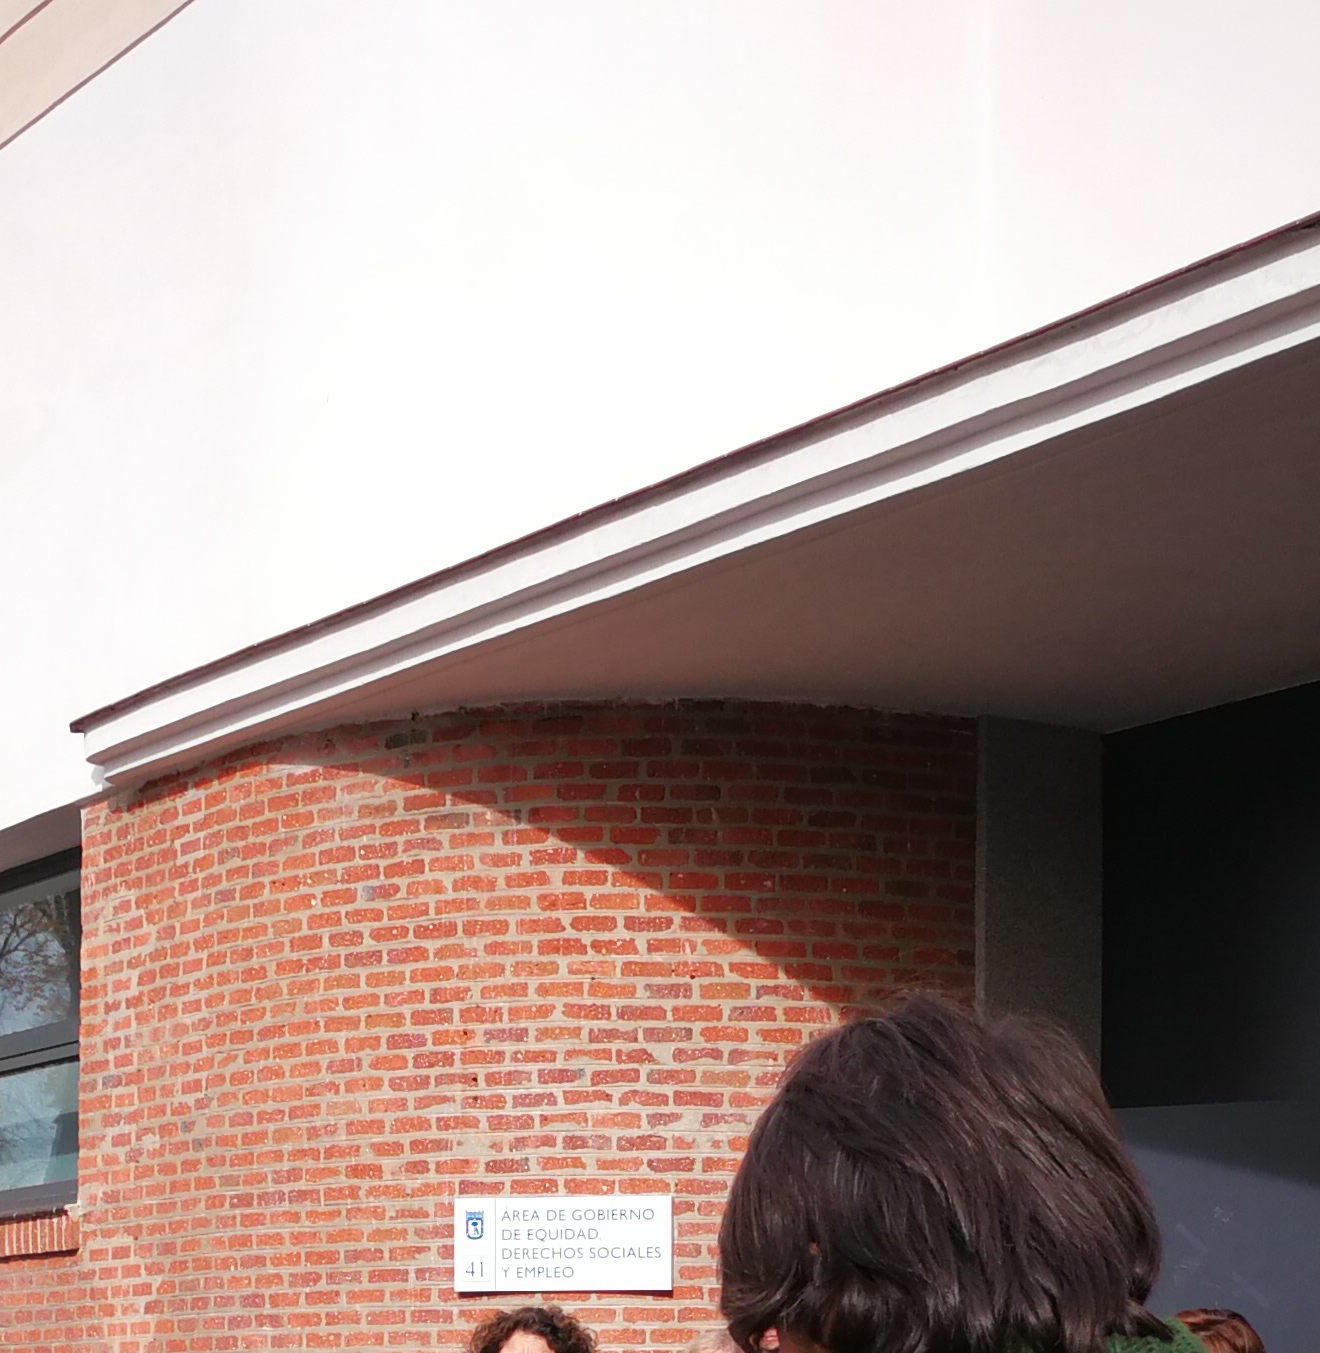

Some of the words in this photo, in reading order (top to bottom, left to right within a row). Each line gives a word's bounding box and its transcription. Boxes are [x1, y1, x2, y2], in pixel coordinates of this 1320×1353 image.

[501, 1207, 540, 1222] ÁREA
[546, 1209, 566, 1221] DE
[572, 1208, 655, 1221] GOBIERNO
[502, 1229, 521, 1241] DE
[502, 1247, 584, 1260] DERECHOS
[589, 1246, 662, 1259] SOCIALES
[465, 1261, 484, 1277] 41
[502, 1266, 510, 1278] Y
[517, 1266, 575, 1279] EMPLEO
